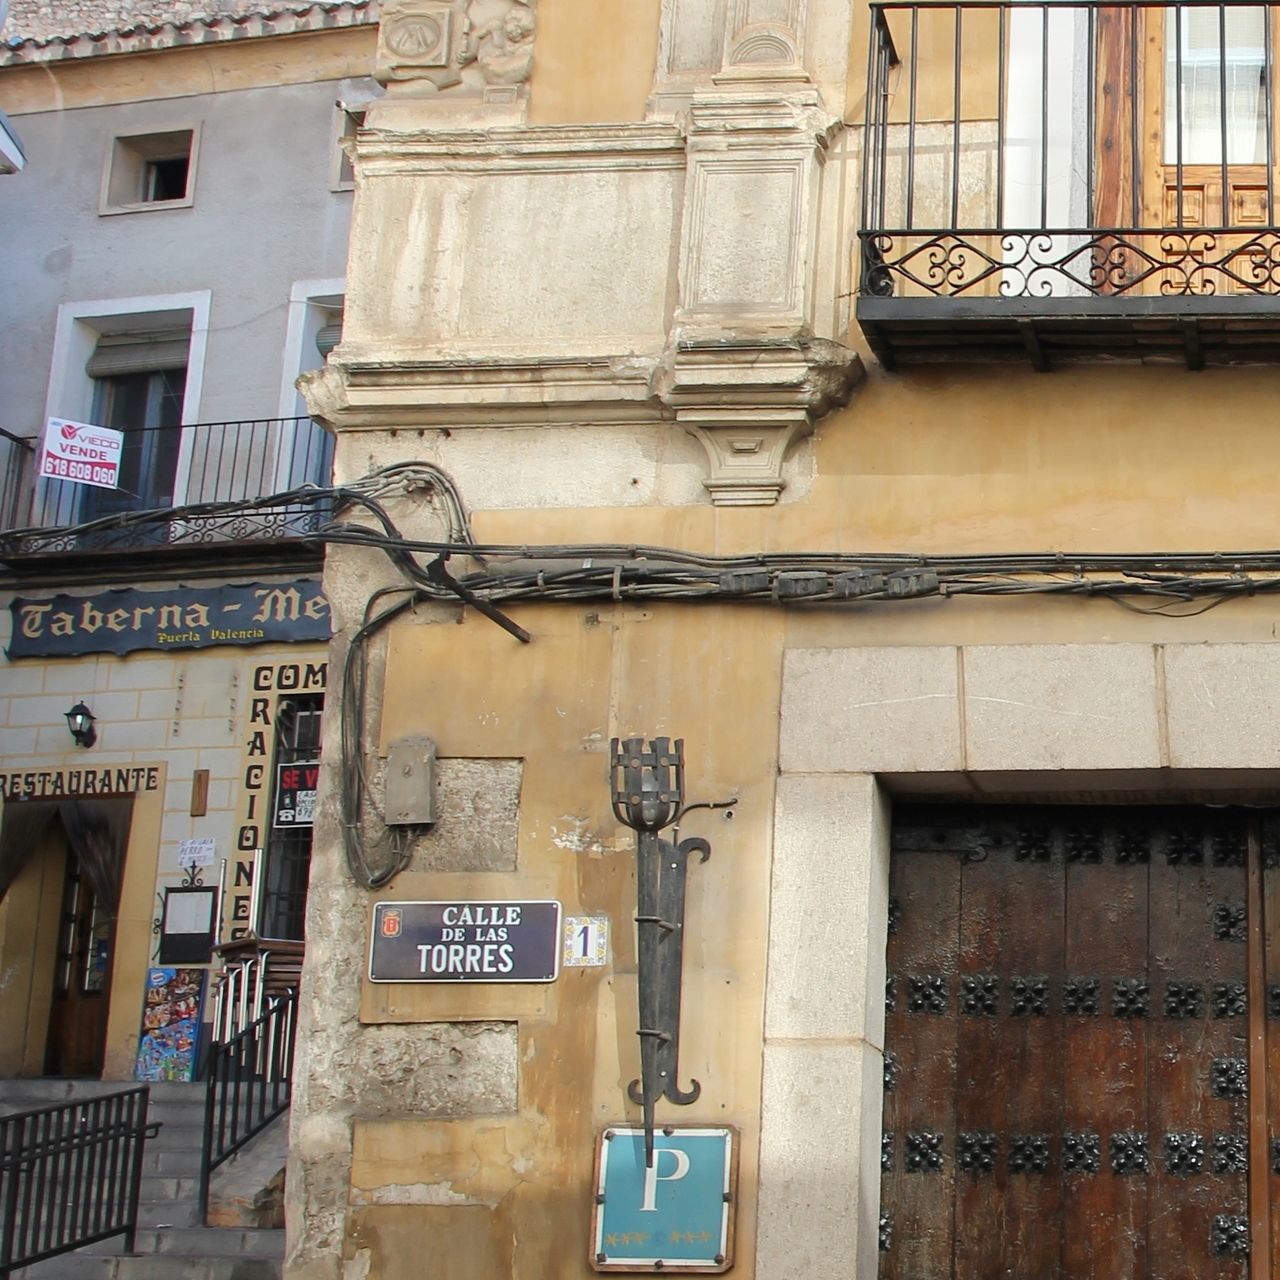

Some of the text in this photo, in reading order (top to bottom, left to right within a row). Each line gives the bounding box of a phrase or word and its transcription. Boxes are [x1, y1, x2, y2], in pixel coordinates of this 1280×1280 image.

[59, 442, 109, 461] VENDE
[45, 457, 116, 485] 618 608 060
[20, 600, 210, 639] Taberna
[210, 628, 265, 640] Valencia
[281, 769, 300, 790] SE
[442, 906, 522, 926] CALLE
[441, 927, 508, 942] DE LAS
[577, 925, 589, 957] 1
[417, 944, 514, 973] TORRES
[639, 1148, 690, 1212] P
